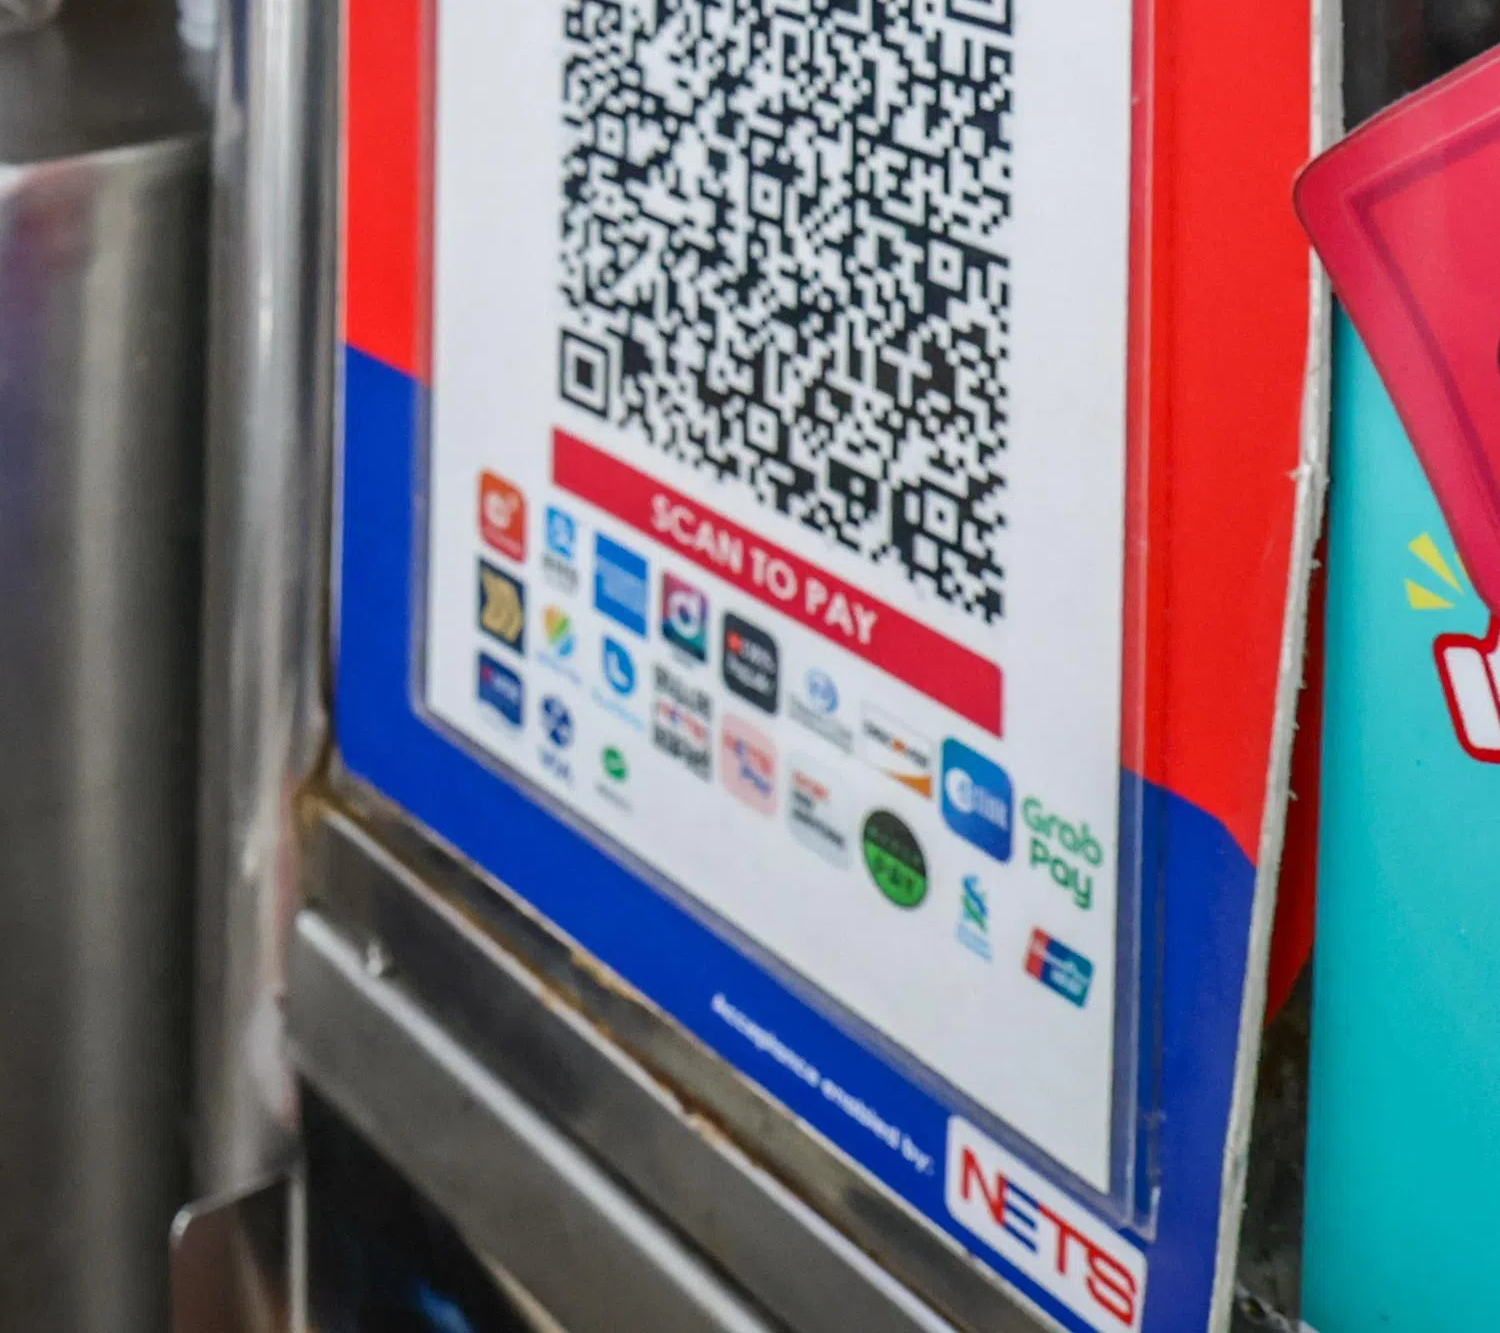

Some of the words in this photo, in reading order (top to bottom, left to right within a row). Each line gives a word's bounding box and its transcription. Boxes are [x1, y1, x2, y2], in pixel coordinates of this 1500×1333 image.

[649, 492, 744, 575] SCAN
[750, 549, 798, 601] TO
[803, 576, 879, 646] PAY
[1021, 796, 1104, 869] Grab
[1029, 836, 1093, 911] Pay
[961, 1144, 1138, 1328] NETS
